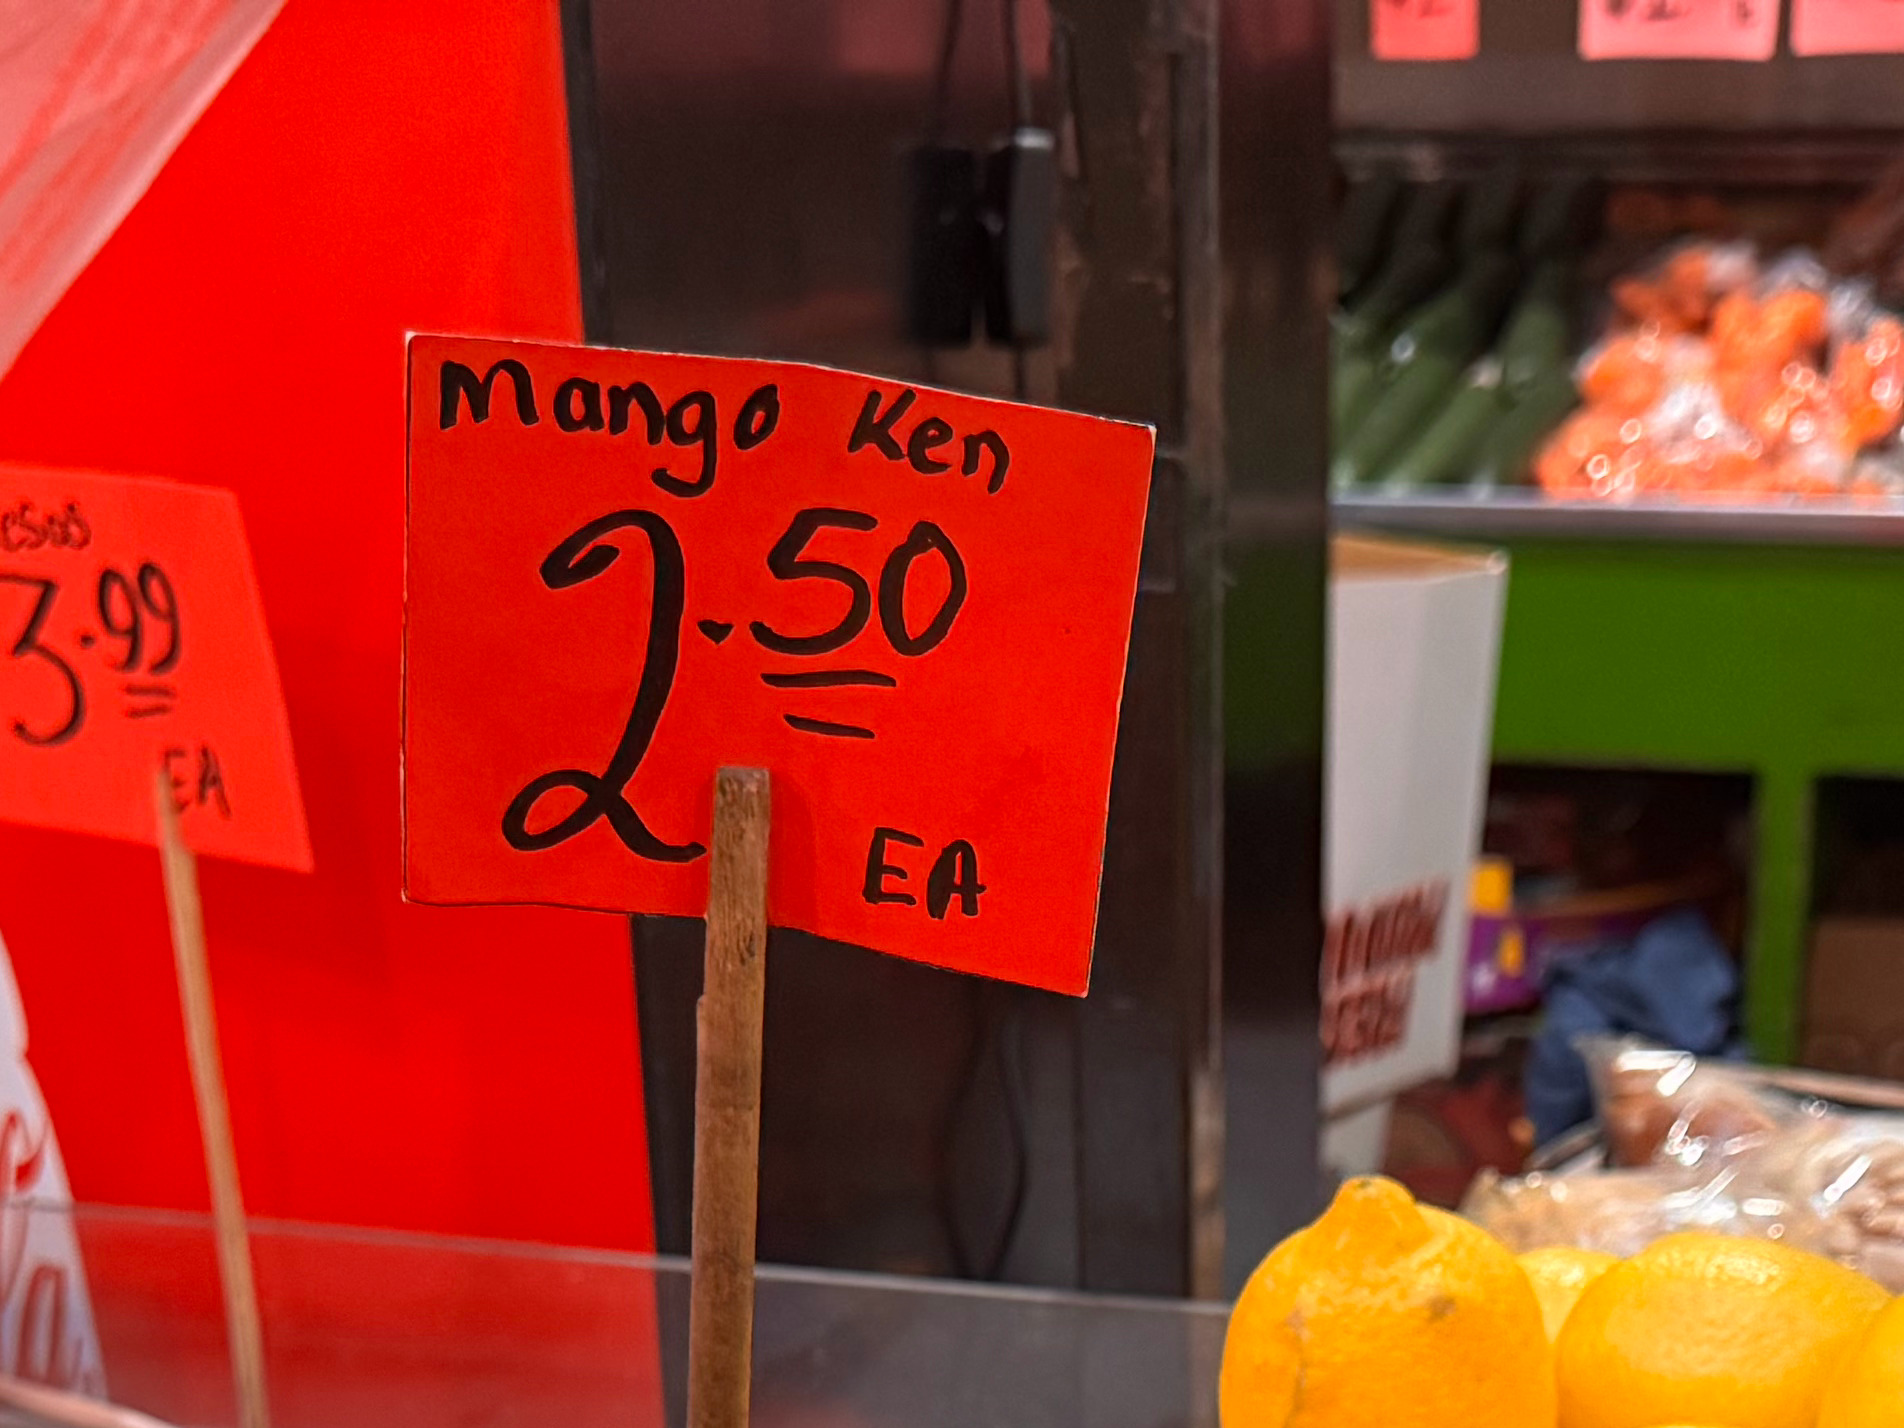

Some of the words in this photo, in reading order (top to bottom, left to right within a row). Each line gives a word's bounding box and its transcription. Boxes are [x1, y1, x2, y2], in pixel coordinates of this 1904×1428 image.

[439, 358, 781, 499] Mango
[847, 387, 1011, 496] Ken
[501, 507, 967, 864] 2.50
[162, 745, 231, 819] EA
[862, 826, 988, 921] EA
